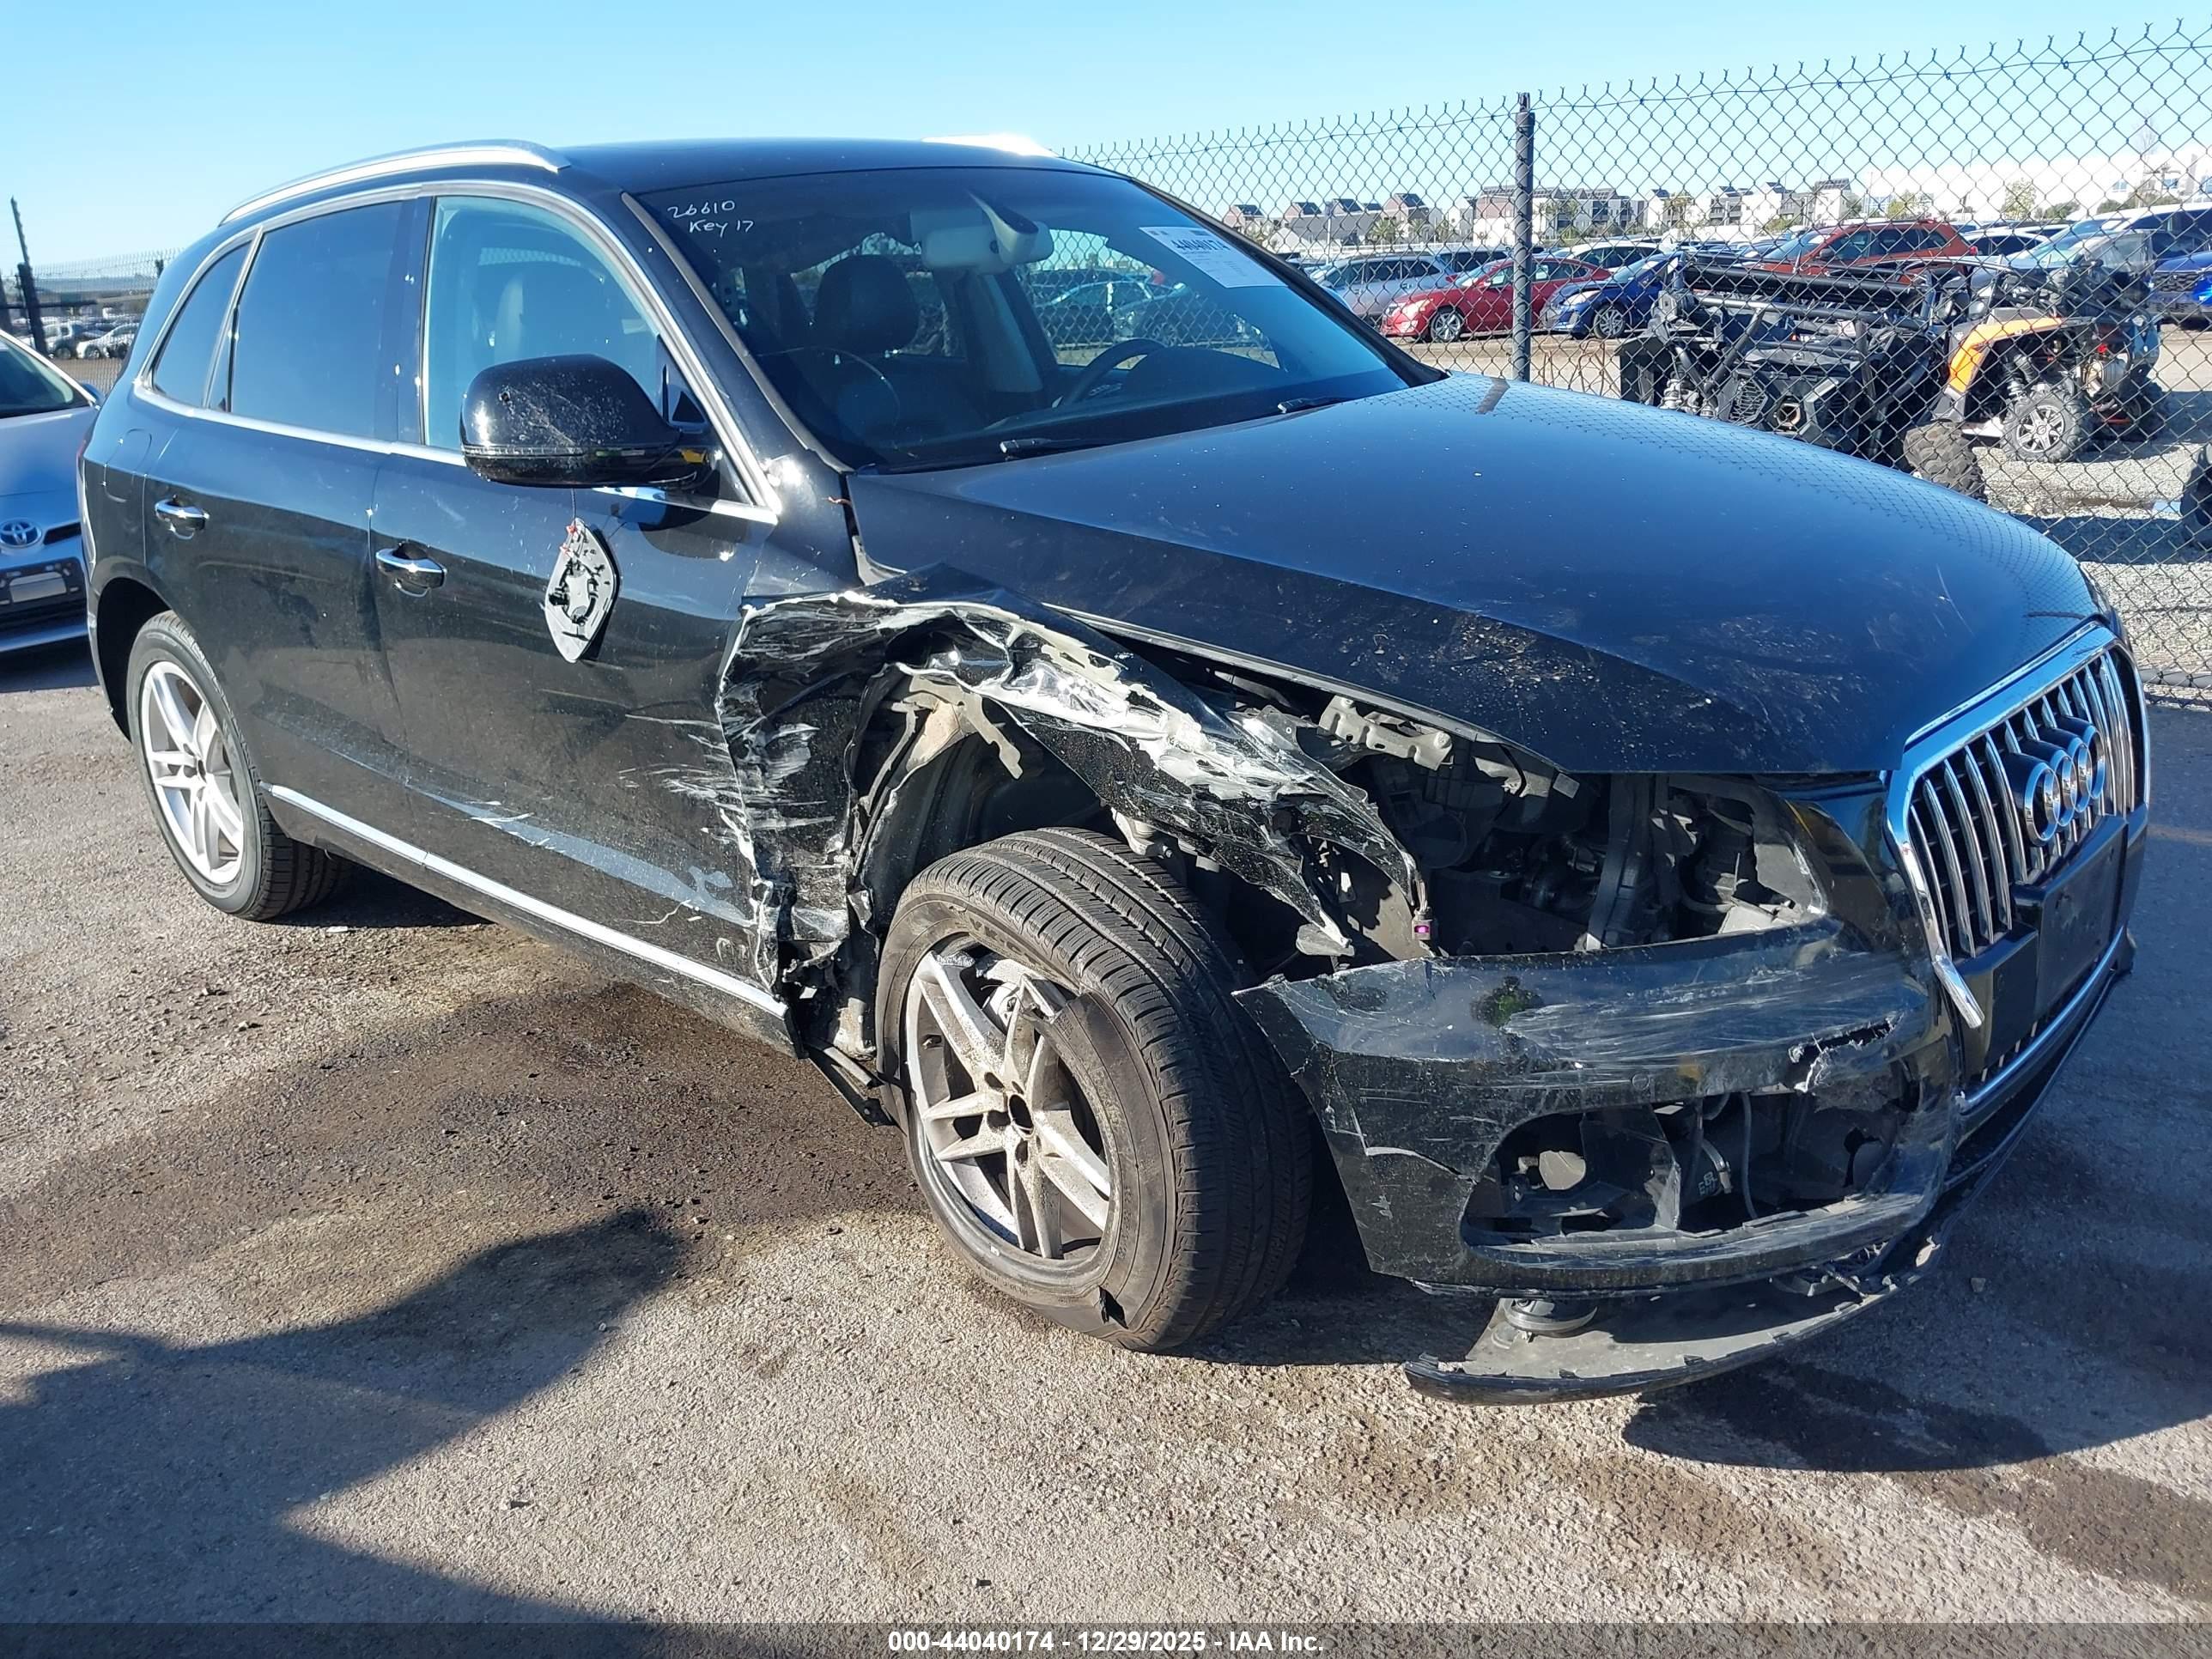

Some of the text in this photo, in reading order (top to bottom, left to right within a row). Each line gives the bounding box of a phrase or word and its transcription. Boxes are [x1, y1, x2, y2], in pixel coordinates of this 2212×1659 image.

[667, 200, 735, 218] 26610
[689, 219, 754, 238] Key 17
